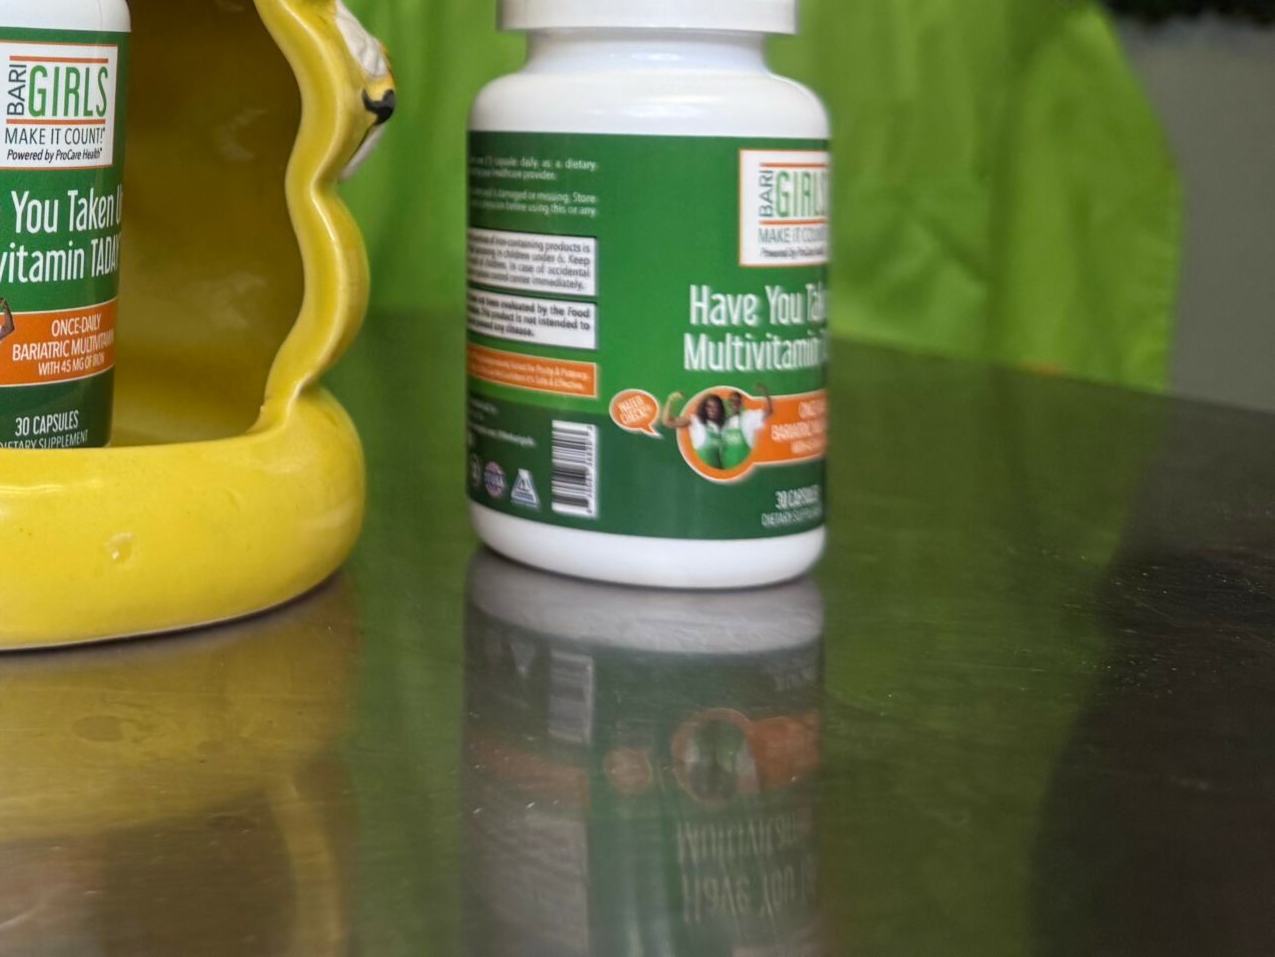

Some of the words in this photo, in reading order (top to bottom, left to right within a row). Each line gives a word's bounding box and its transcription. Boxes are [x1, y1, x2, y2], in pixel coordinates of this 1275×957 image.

[7, 64, 27, 116] BARI
[28, 65, 109, 117] GIRLS
[5, 127, 46, 145] MAKE
[50, 127, 62, 145] IT
[6, 149, 44, 161] Powered
[44, 149, 55, 164] by
[55, 149, 82, 161] ProCare
[565, 158, 597, 172] dietary
[572, 191, 597, 203] Store
[759, 170, 773, 217] BARI
[11, 190, 60, 234] You
[67, 187, 114, 232] Taken
[545, 241, 581, 254] products
[547, 265, 590, 278] accidental
[567, 306, 590, 318] Food
[690, 284, 758, 326] Have
[765, 285, 803, 325] You
[51, 313, 102, 337] ONCE-DAILY
[12, 340, 70, 361] BARIATRIC
[684, 332, 820, 372] Multivitamin
[38, 361, 60, 376] WITH
[61, 359, 72, 374] 45
[72, 357, 84, 371] MG
[15, 415, 30, 437] 30
[33, 410, 79, 435] CAPSULES
